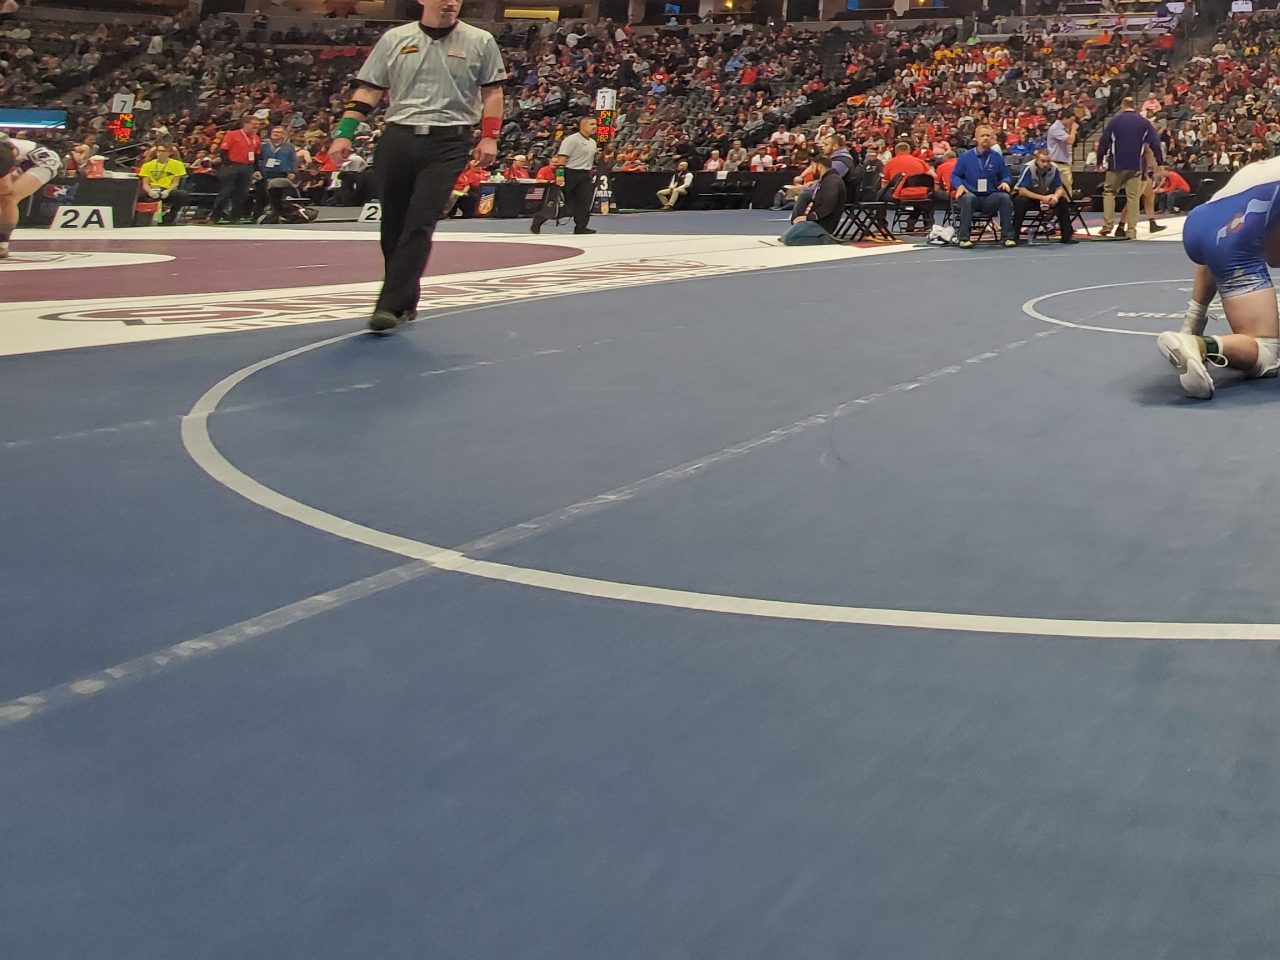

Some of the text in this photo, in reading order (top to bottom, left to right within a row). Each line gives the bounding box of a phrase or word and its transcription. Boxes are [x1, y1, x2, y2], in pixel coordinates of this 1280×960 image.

[120, 100, 127, 112] 7
[600, 95, 606, 109] 3
[600, 175, 608, 190] 3
[596, 190, 612, 198] MAT
[60, 208, 106, 229] 2A
[364, 205, 381, 221] 2
